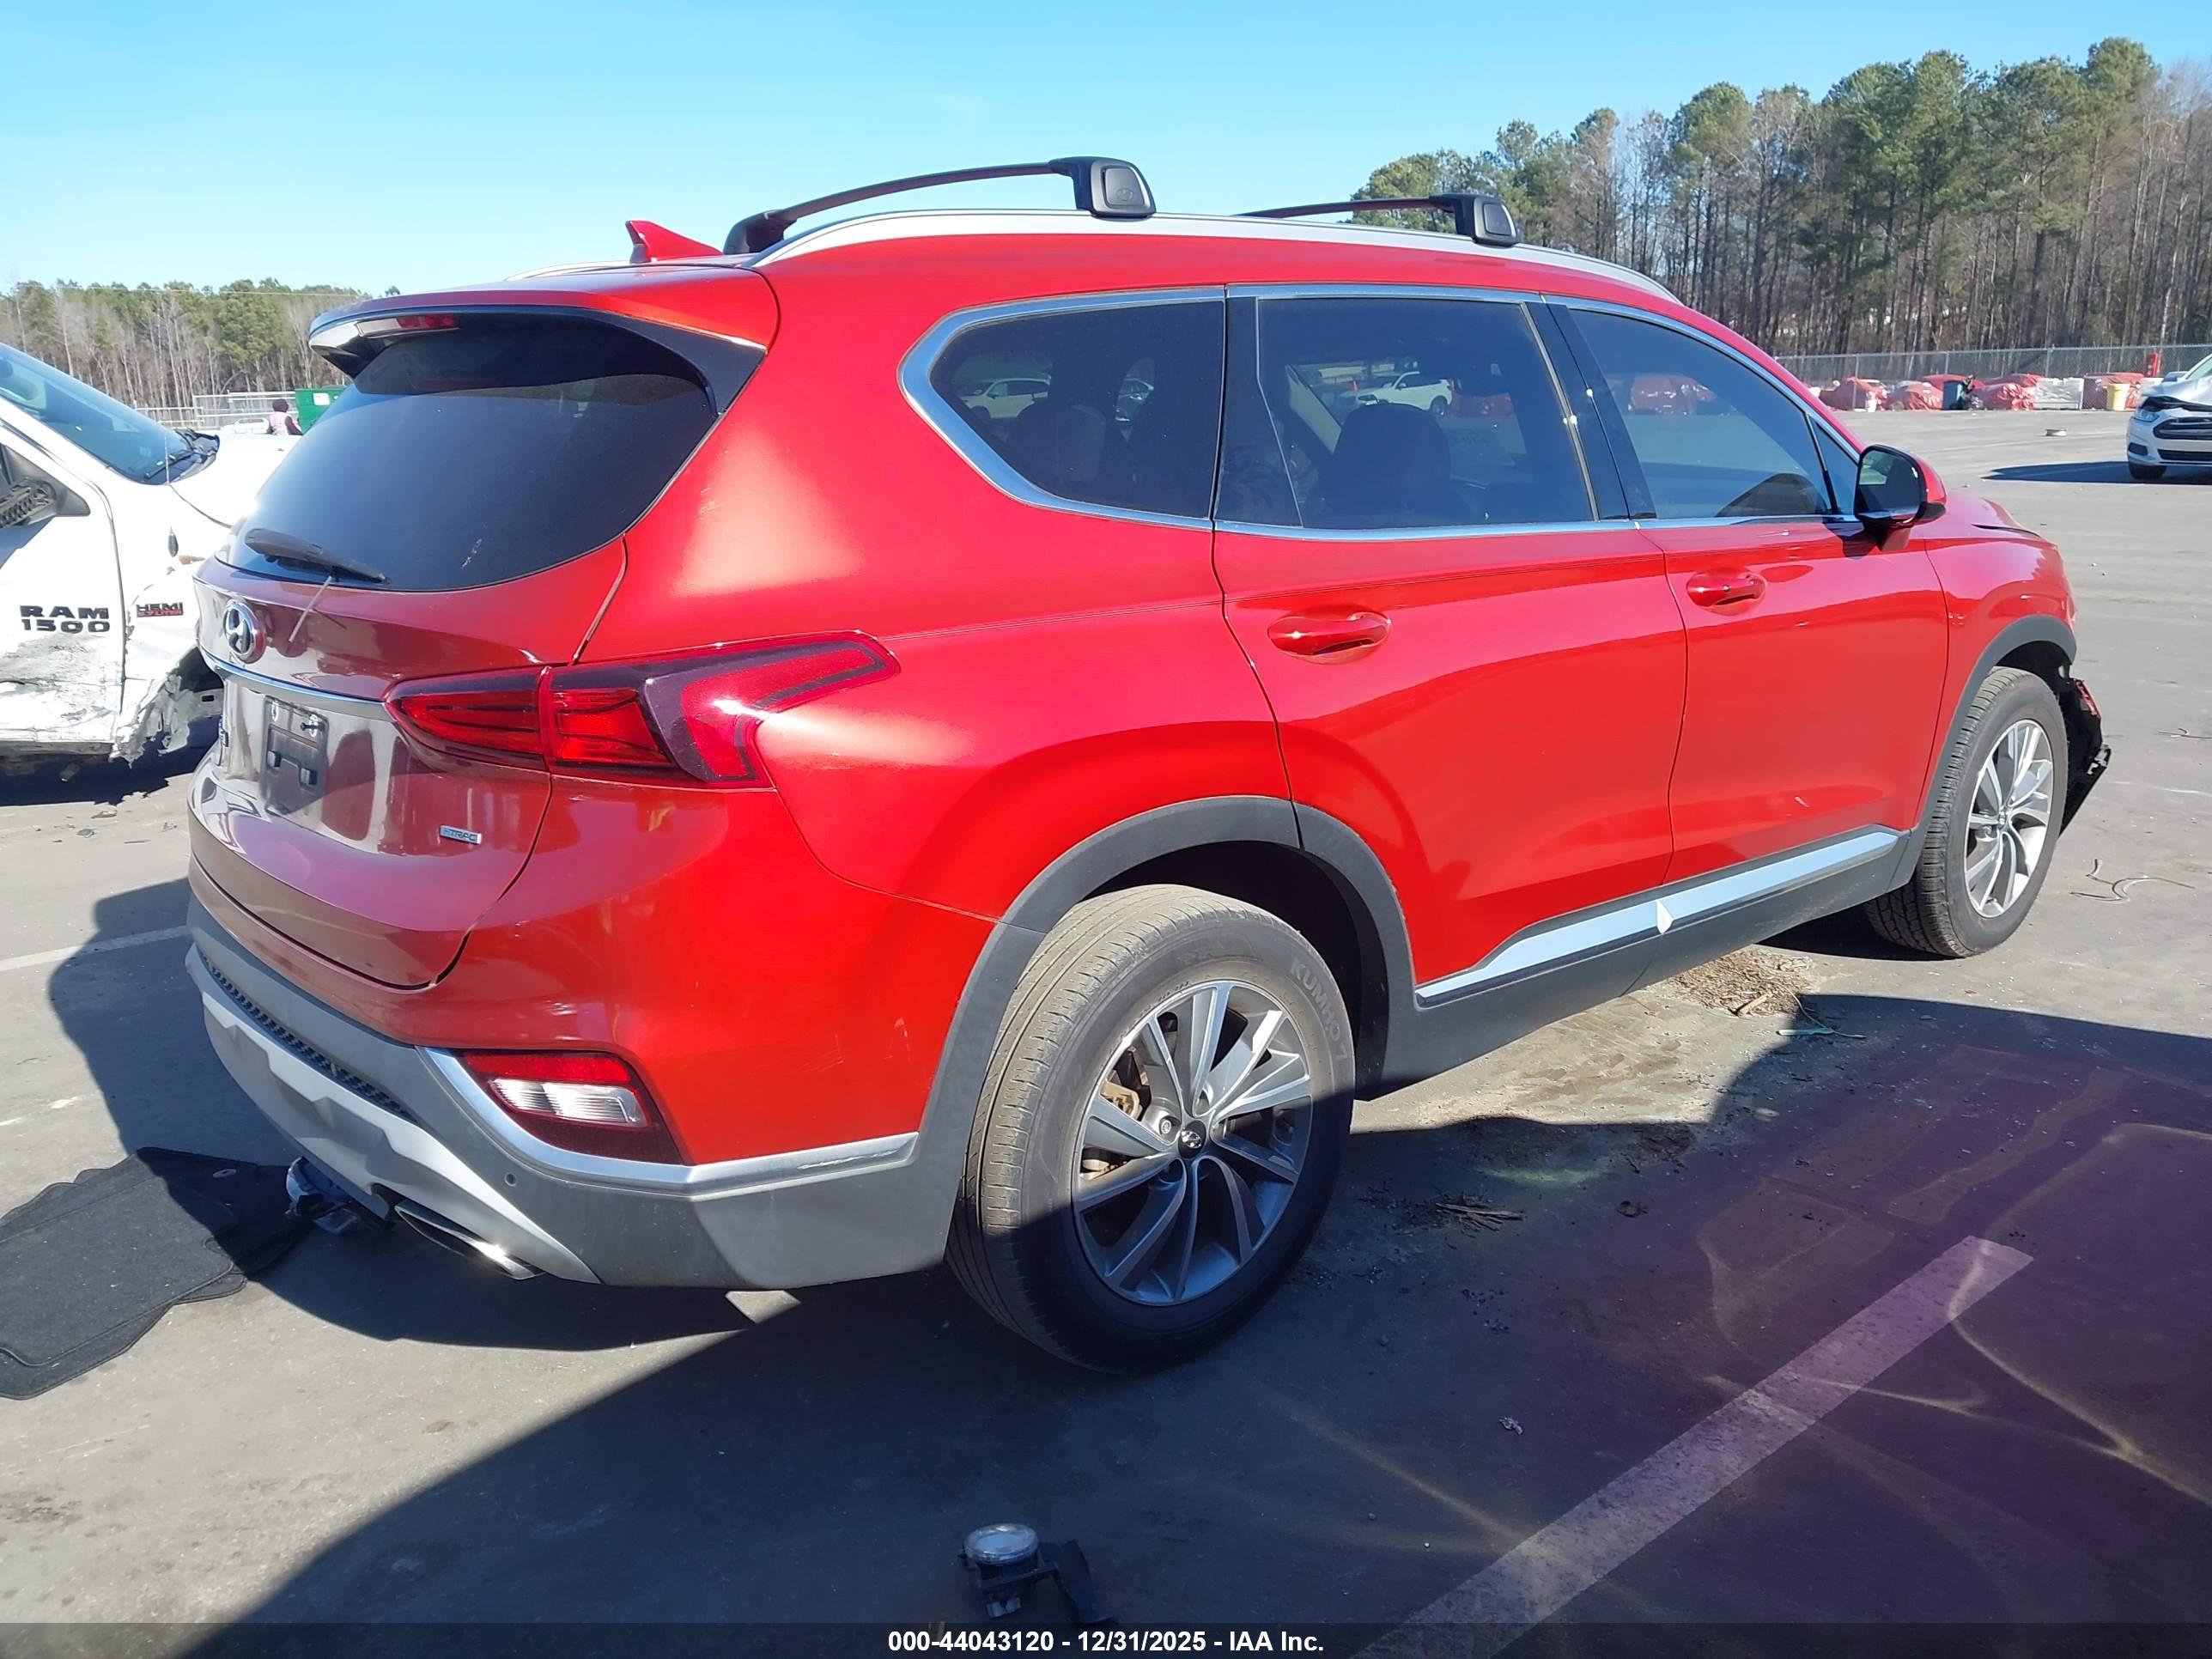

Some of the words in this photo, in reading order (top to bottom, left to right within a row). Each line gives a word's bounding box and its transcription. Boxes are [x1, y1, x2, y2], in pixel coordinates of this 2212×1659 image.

[20, 605, 109, 619] RAM
[137, 602, 183, 611] HEMI
[21, 619, 110, 634] 1500
[1290, 957, 1340, 1042] KUMHO
